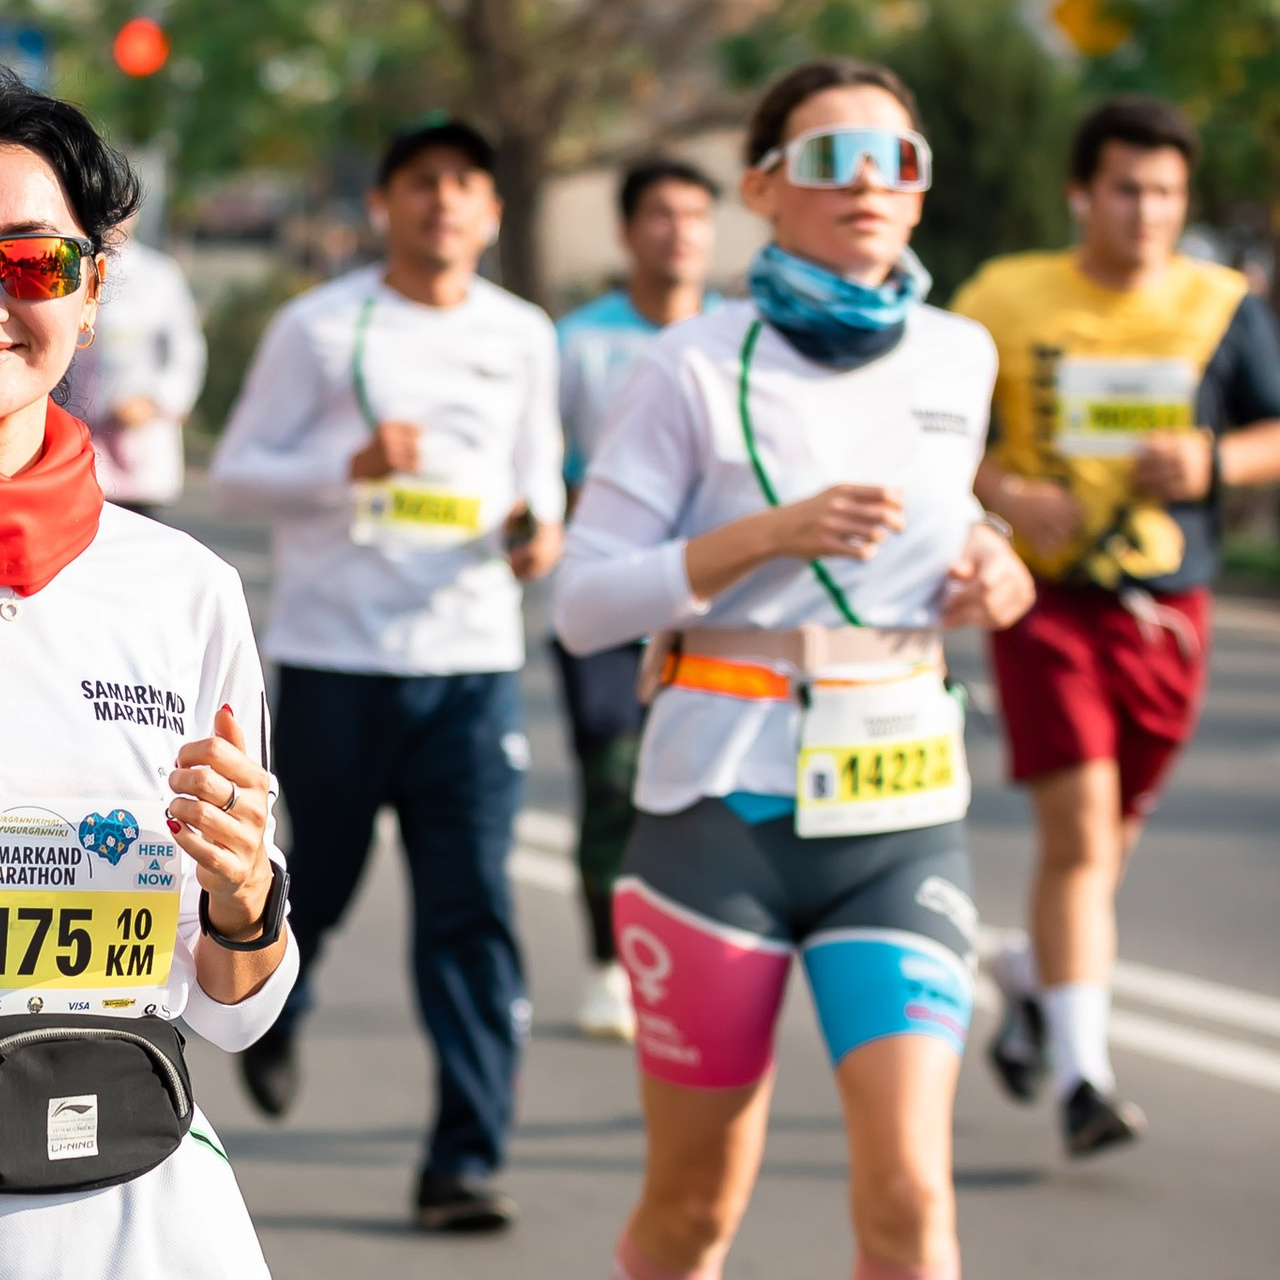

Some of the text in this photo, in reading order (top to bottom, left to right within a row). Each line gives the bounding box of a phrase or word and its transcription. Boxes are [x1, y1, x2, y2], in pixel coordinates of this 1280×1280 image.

[93, 701, 185, 736] MARATHN
[139, 844, 173, 857] HERE
[138, 873, 173, 886] NOW
[116, 908, 153, 940] 10
[105, 944, 155, 977] KM
[68, 1001, 90, 1011] VISA
[51, 1140, 95, 1153] LI-NING
